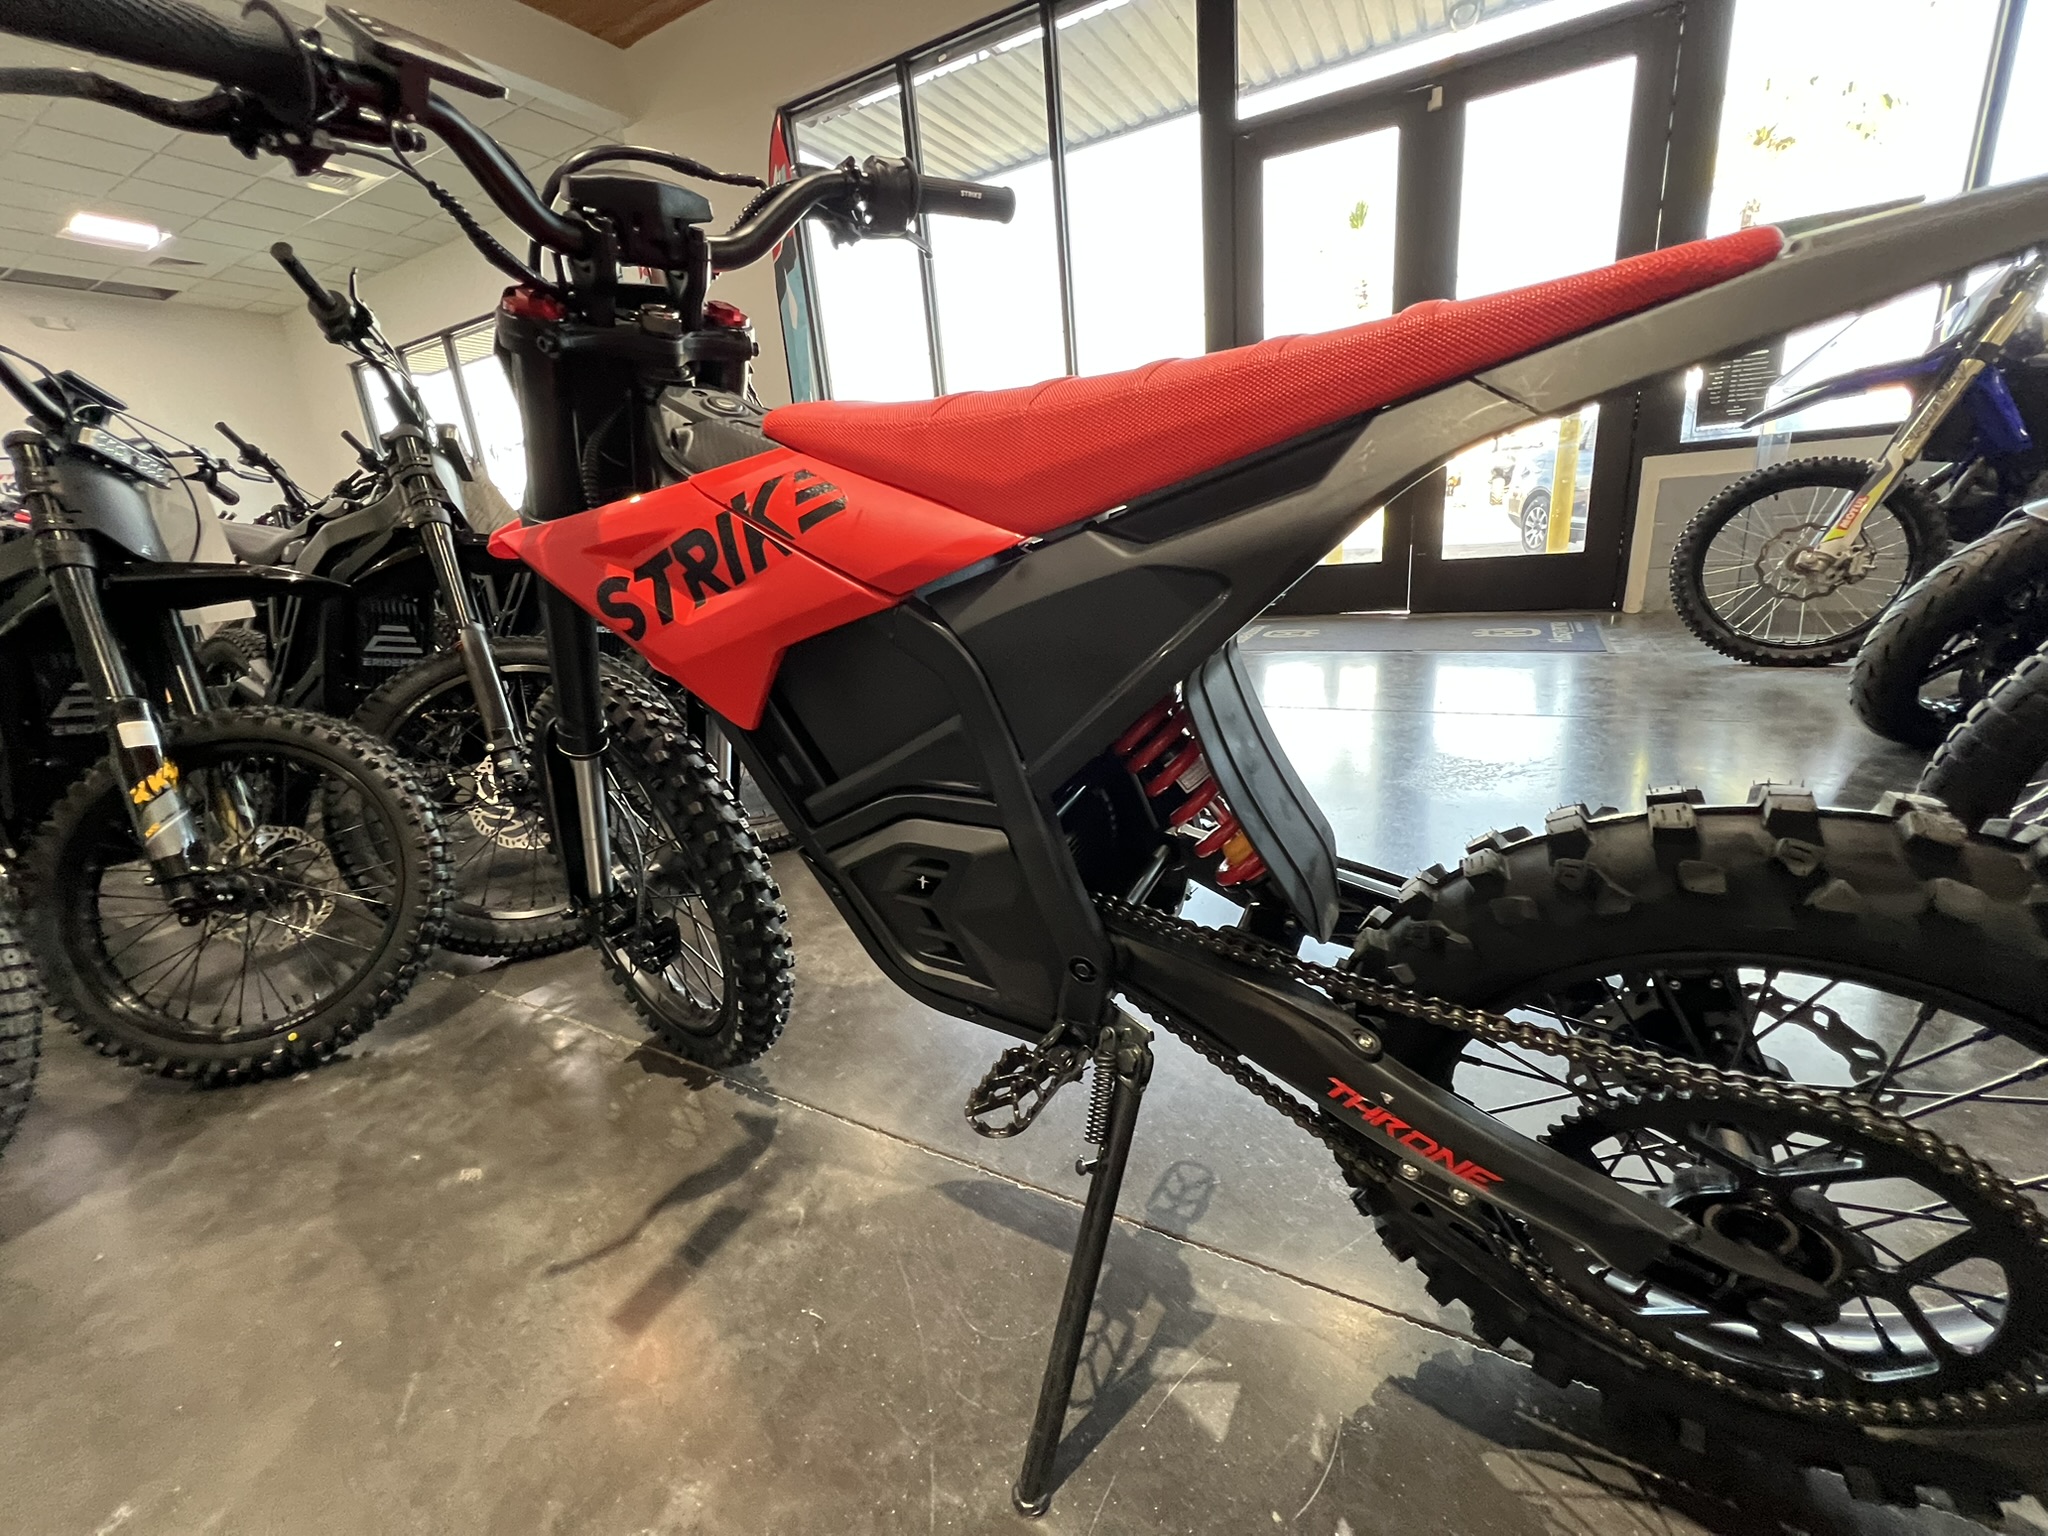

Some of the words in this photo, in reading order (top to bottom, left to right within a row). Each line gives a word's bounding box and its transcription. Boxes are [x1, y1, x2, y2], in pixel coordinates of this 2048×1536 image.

[597, 469, 848, 641] STRIKE
[1839, 496, 1868, 529] MOTUL
[1327, 1077, 1504, 1192] THRONE
